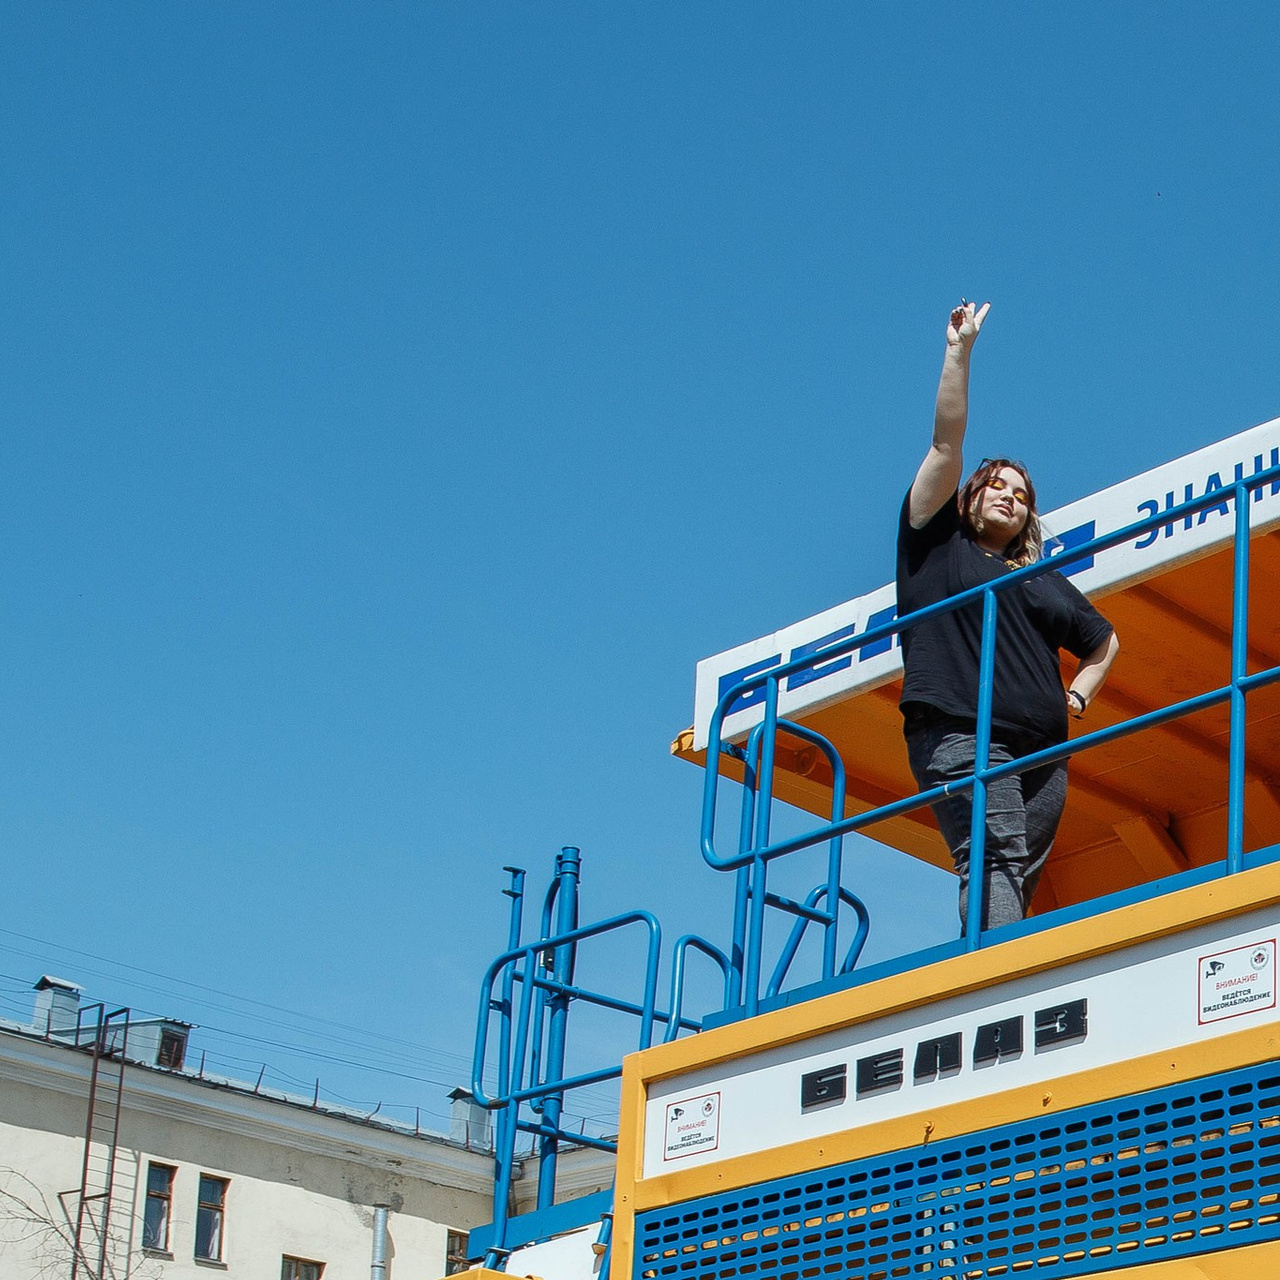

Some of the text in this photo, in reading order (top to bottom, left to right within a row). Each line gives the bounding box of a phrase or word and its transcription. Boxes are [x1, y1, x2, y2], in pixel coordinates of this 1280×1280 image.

[1215, 972, 1259, 990] ВНИМАНИЕ!
[1202, 991, 1272, 1014] ВИДЕОНАБЛЮДЕНИЕ
[801, 998, 1088, 1110] БЕЛАЗ
